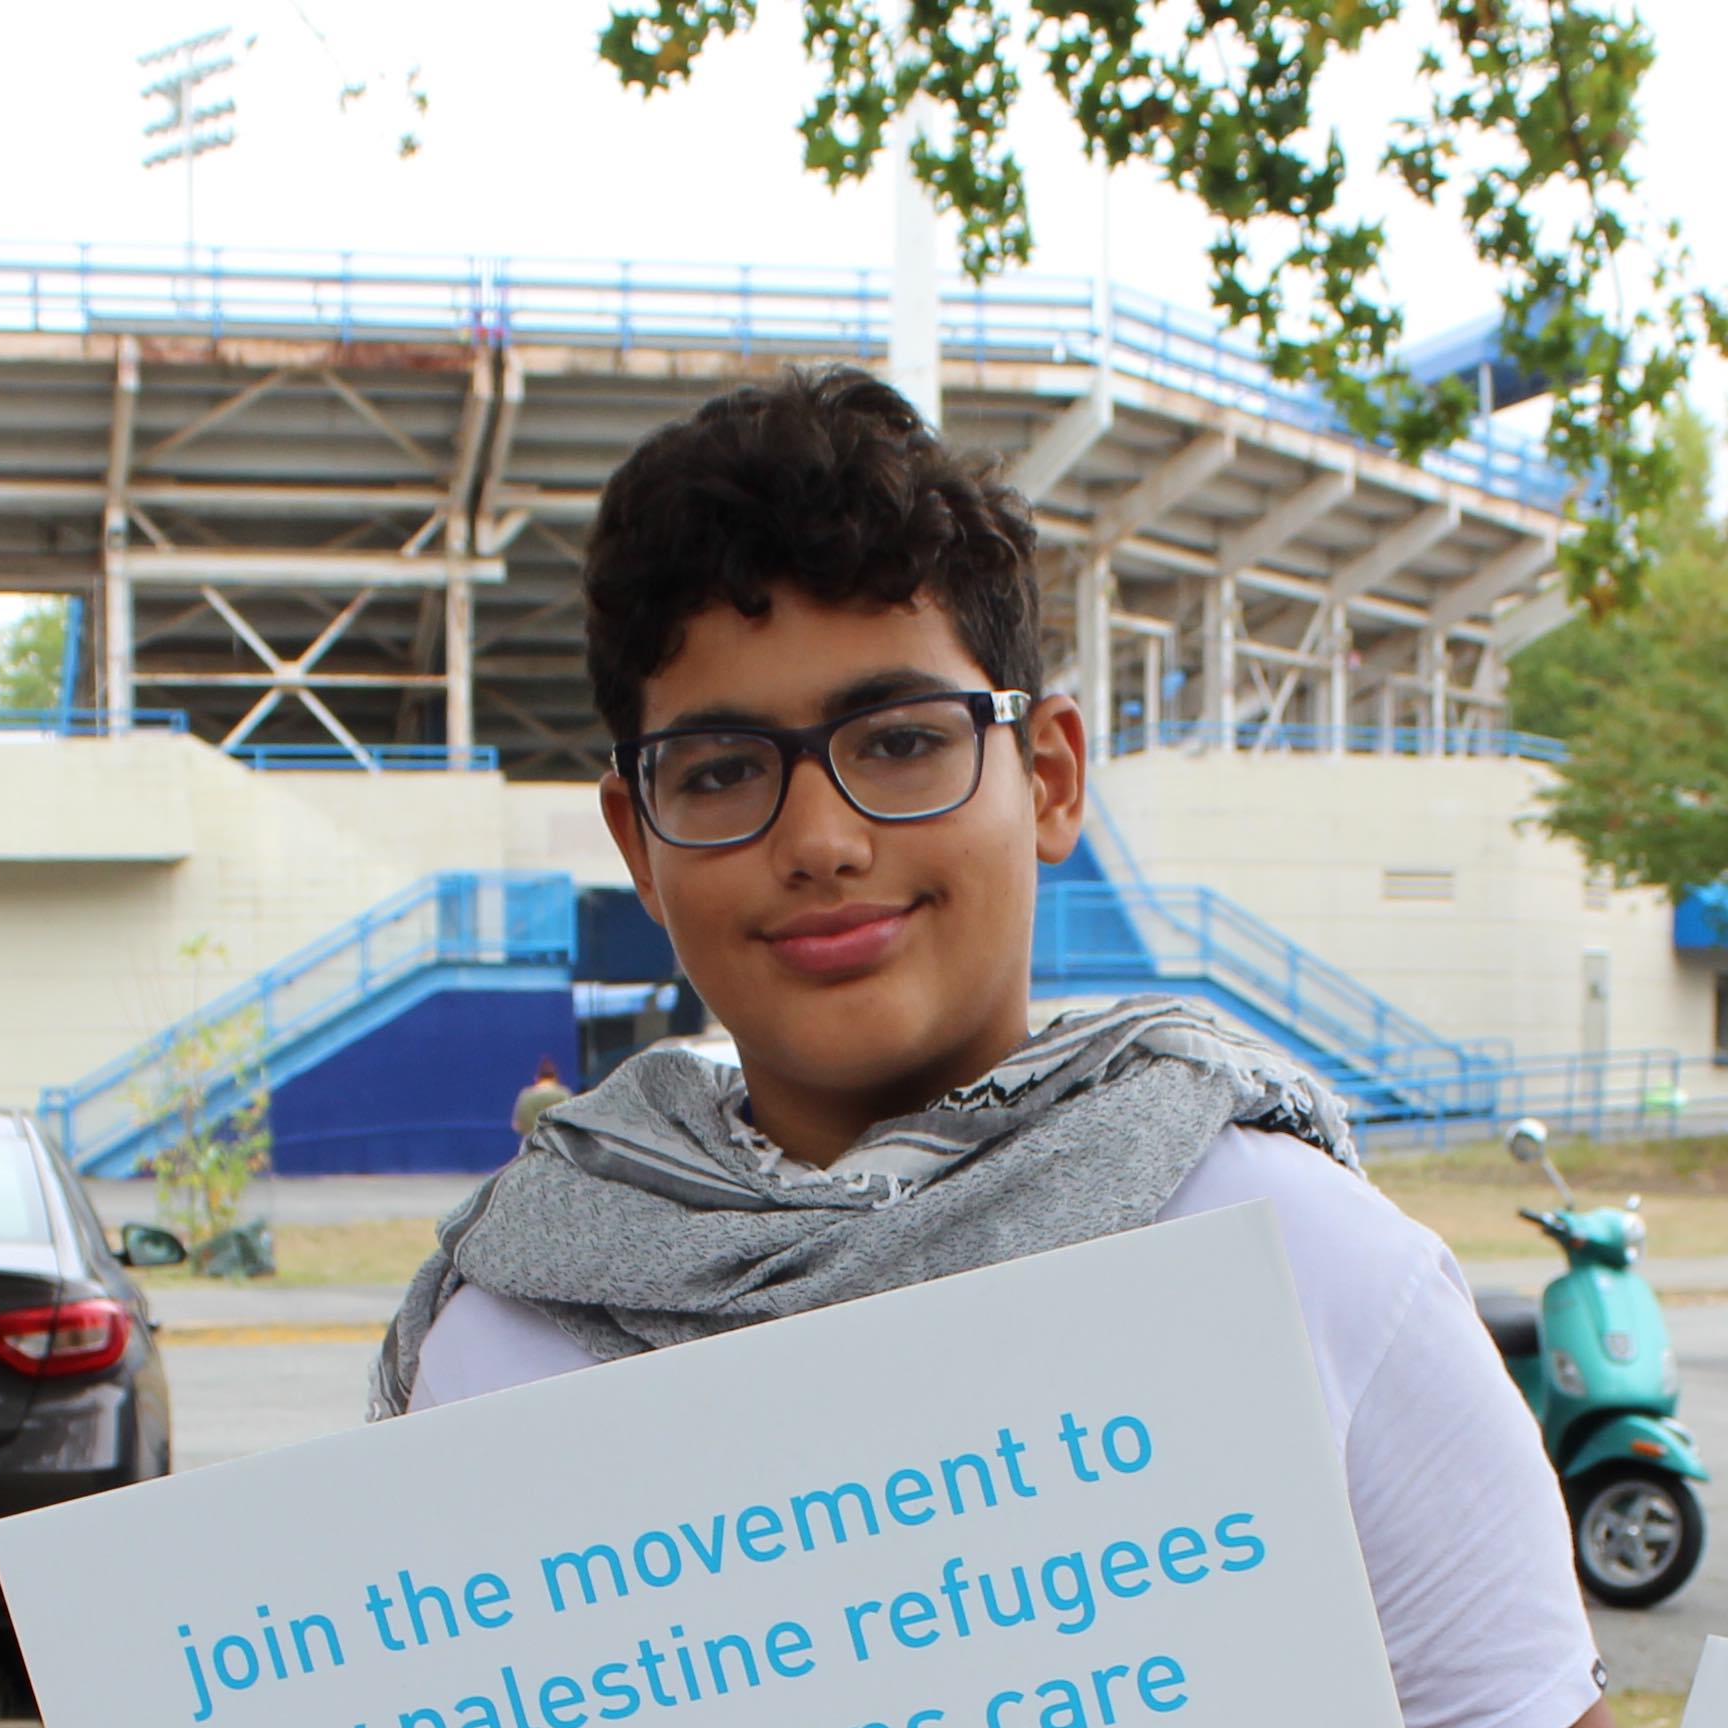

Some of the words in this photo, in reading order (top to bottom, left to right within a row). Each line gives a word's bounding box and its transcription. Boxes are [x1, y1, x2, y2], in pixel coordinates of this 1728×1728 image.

[176, 1601, 346, 1724] join
[364, 1568, 515, 1653] the
[539, 1427, 1039, 1614] movement
[1057, 1411, 1154, 1484] to
[843, 1511, 1267, 1663] refugees
